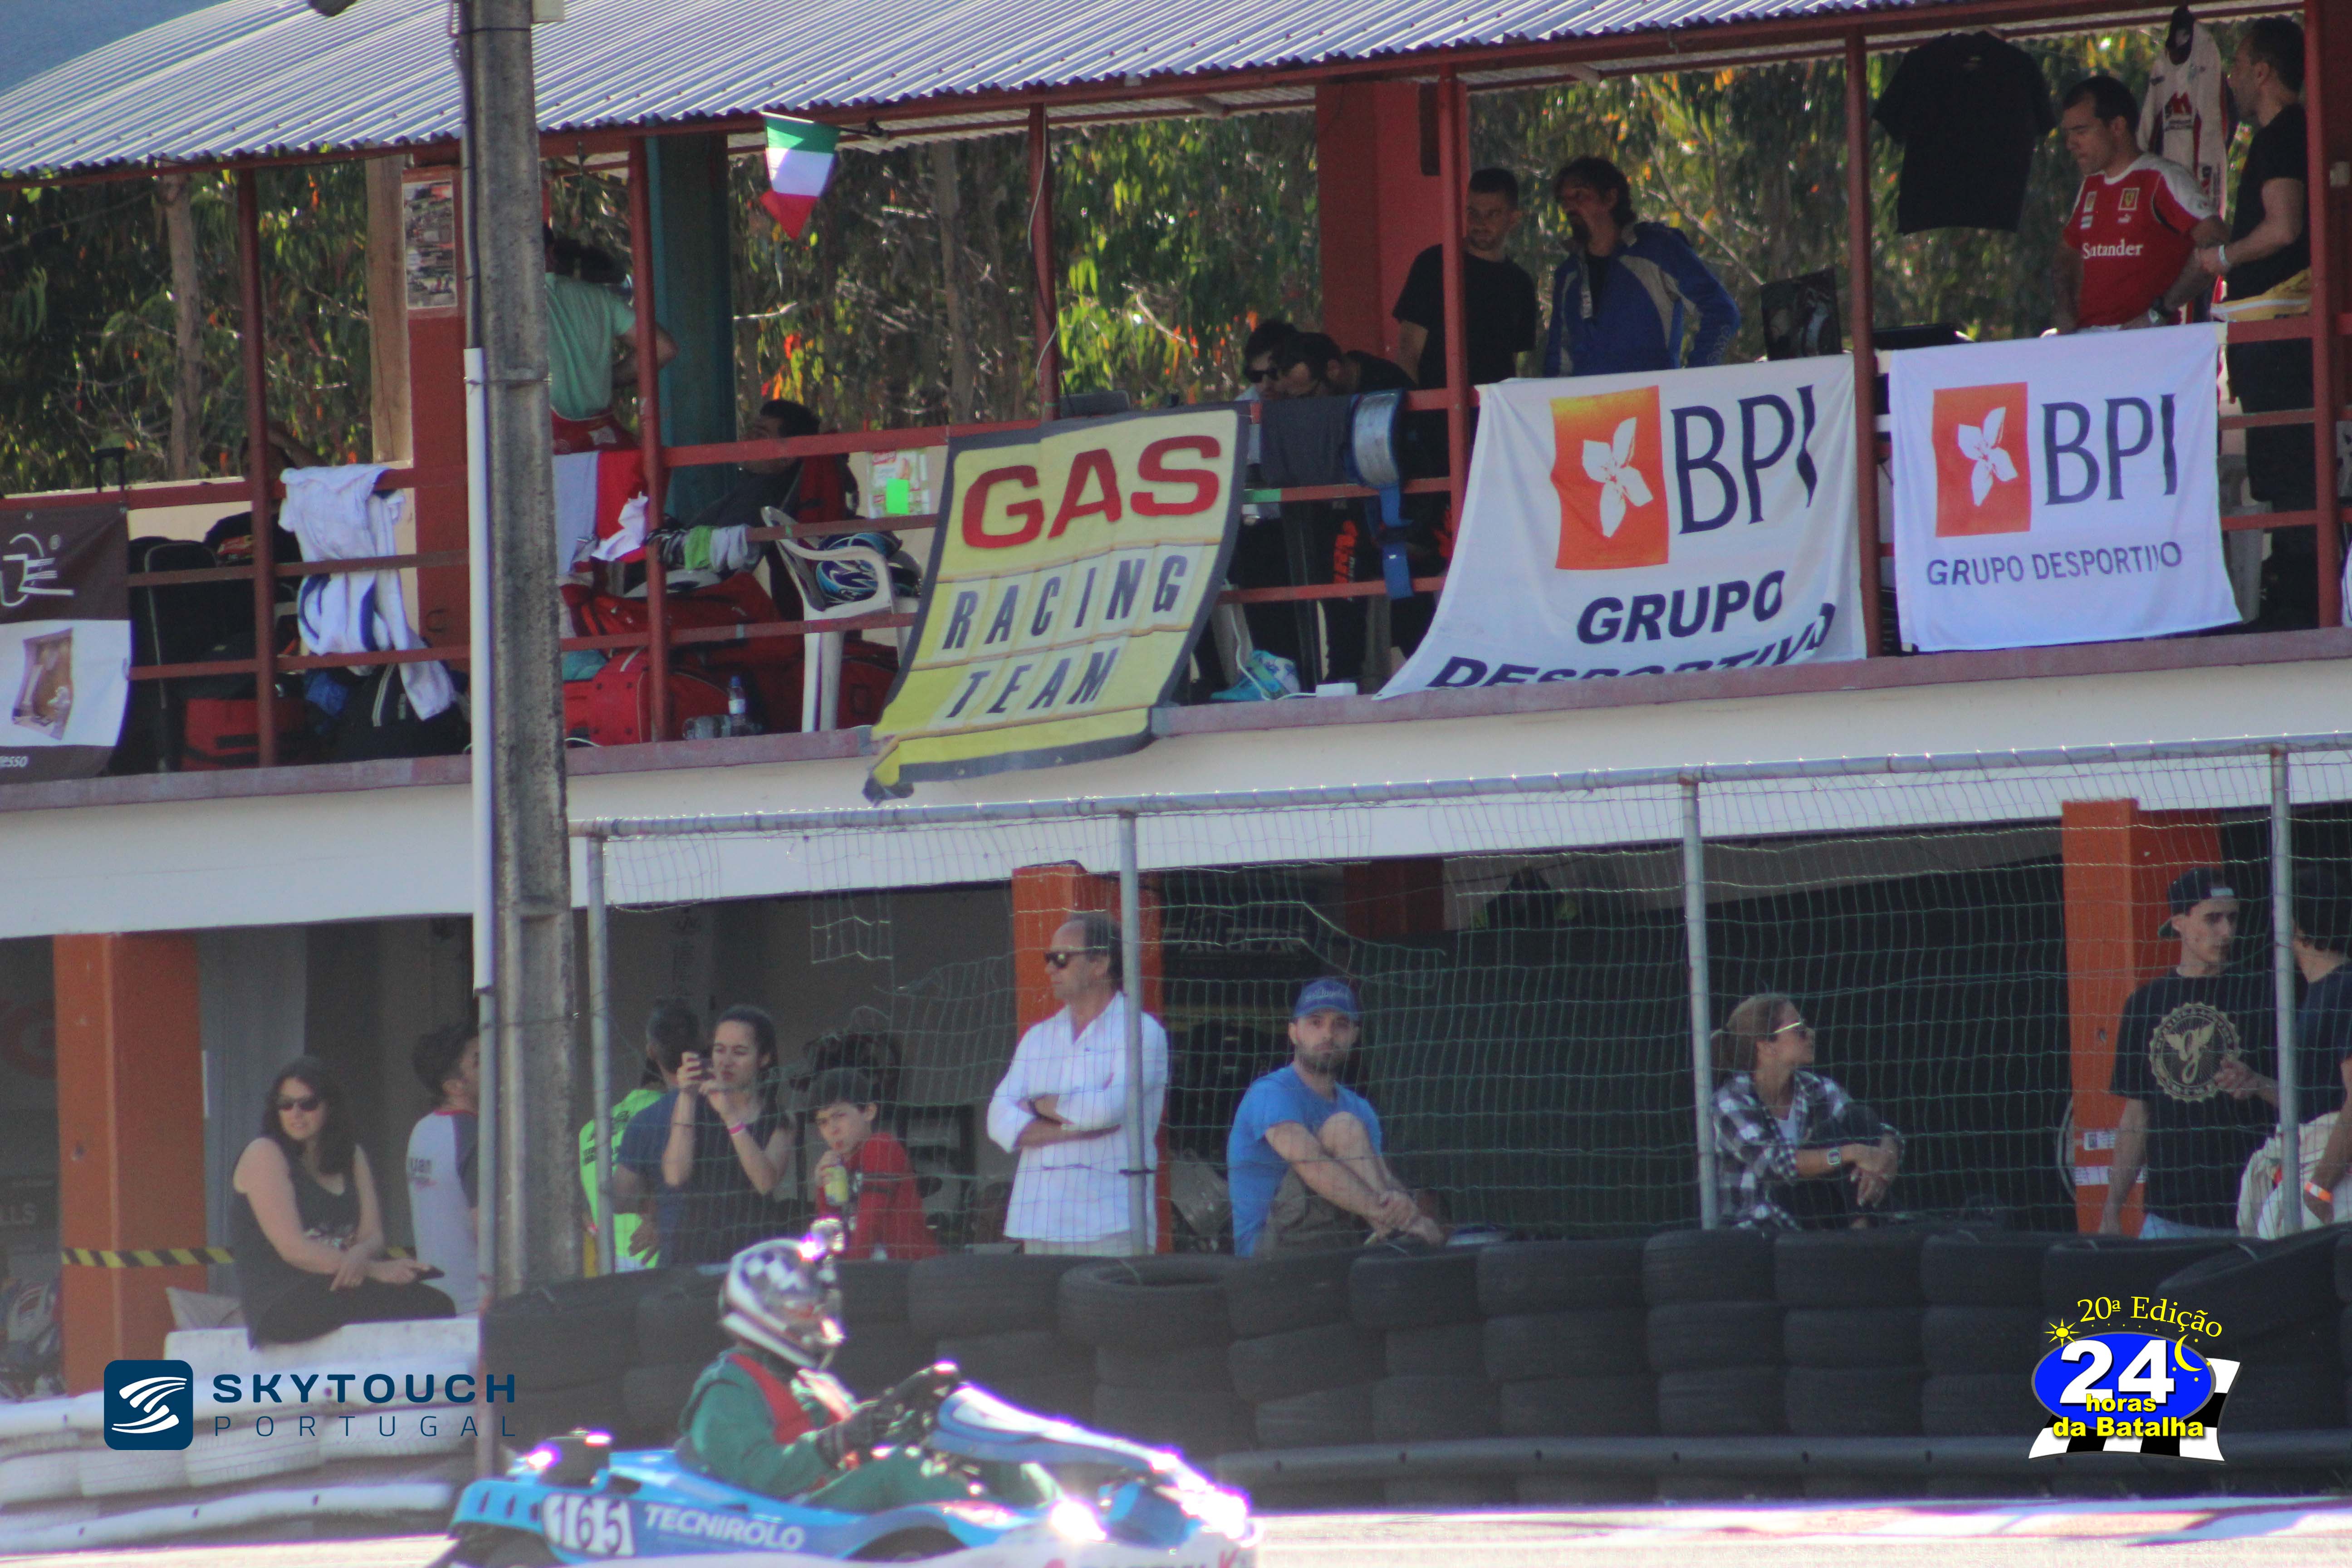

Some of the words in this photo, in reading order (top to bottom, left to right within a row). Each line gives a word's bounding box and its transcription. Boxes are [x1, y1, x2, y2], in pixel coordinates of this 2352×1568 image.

[962, 435, 1221, 549] GAS
[1671, 384, 1817, 534] BPI
[2041, 393, 2178, 505] BPI
[941, 554, 1189, 650] RACING
[1576, 569, 1786, 645] GRUPO
[1926, 554, 2024, 586] GRUPO
[945, 647, 1120, 719] TEAM
[644, 1502, 805, 1551] TECNIROLO
